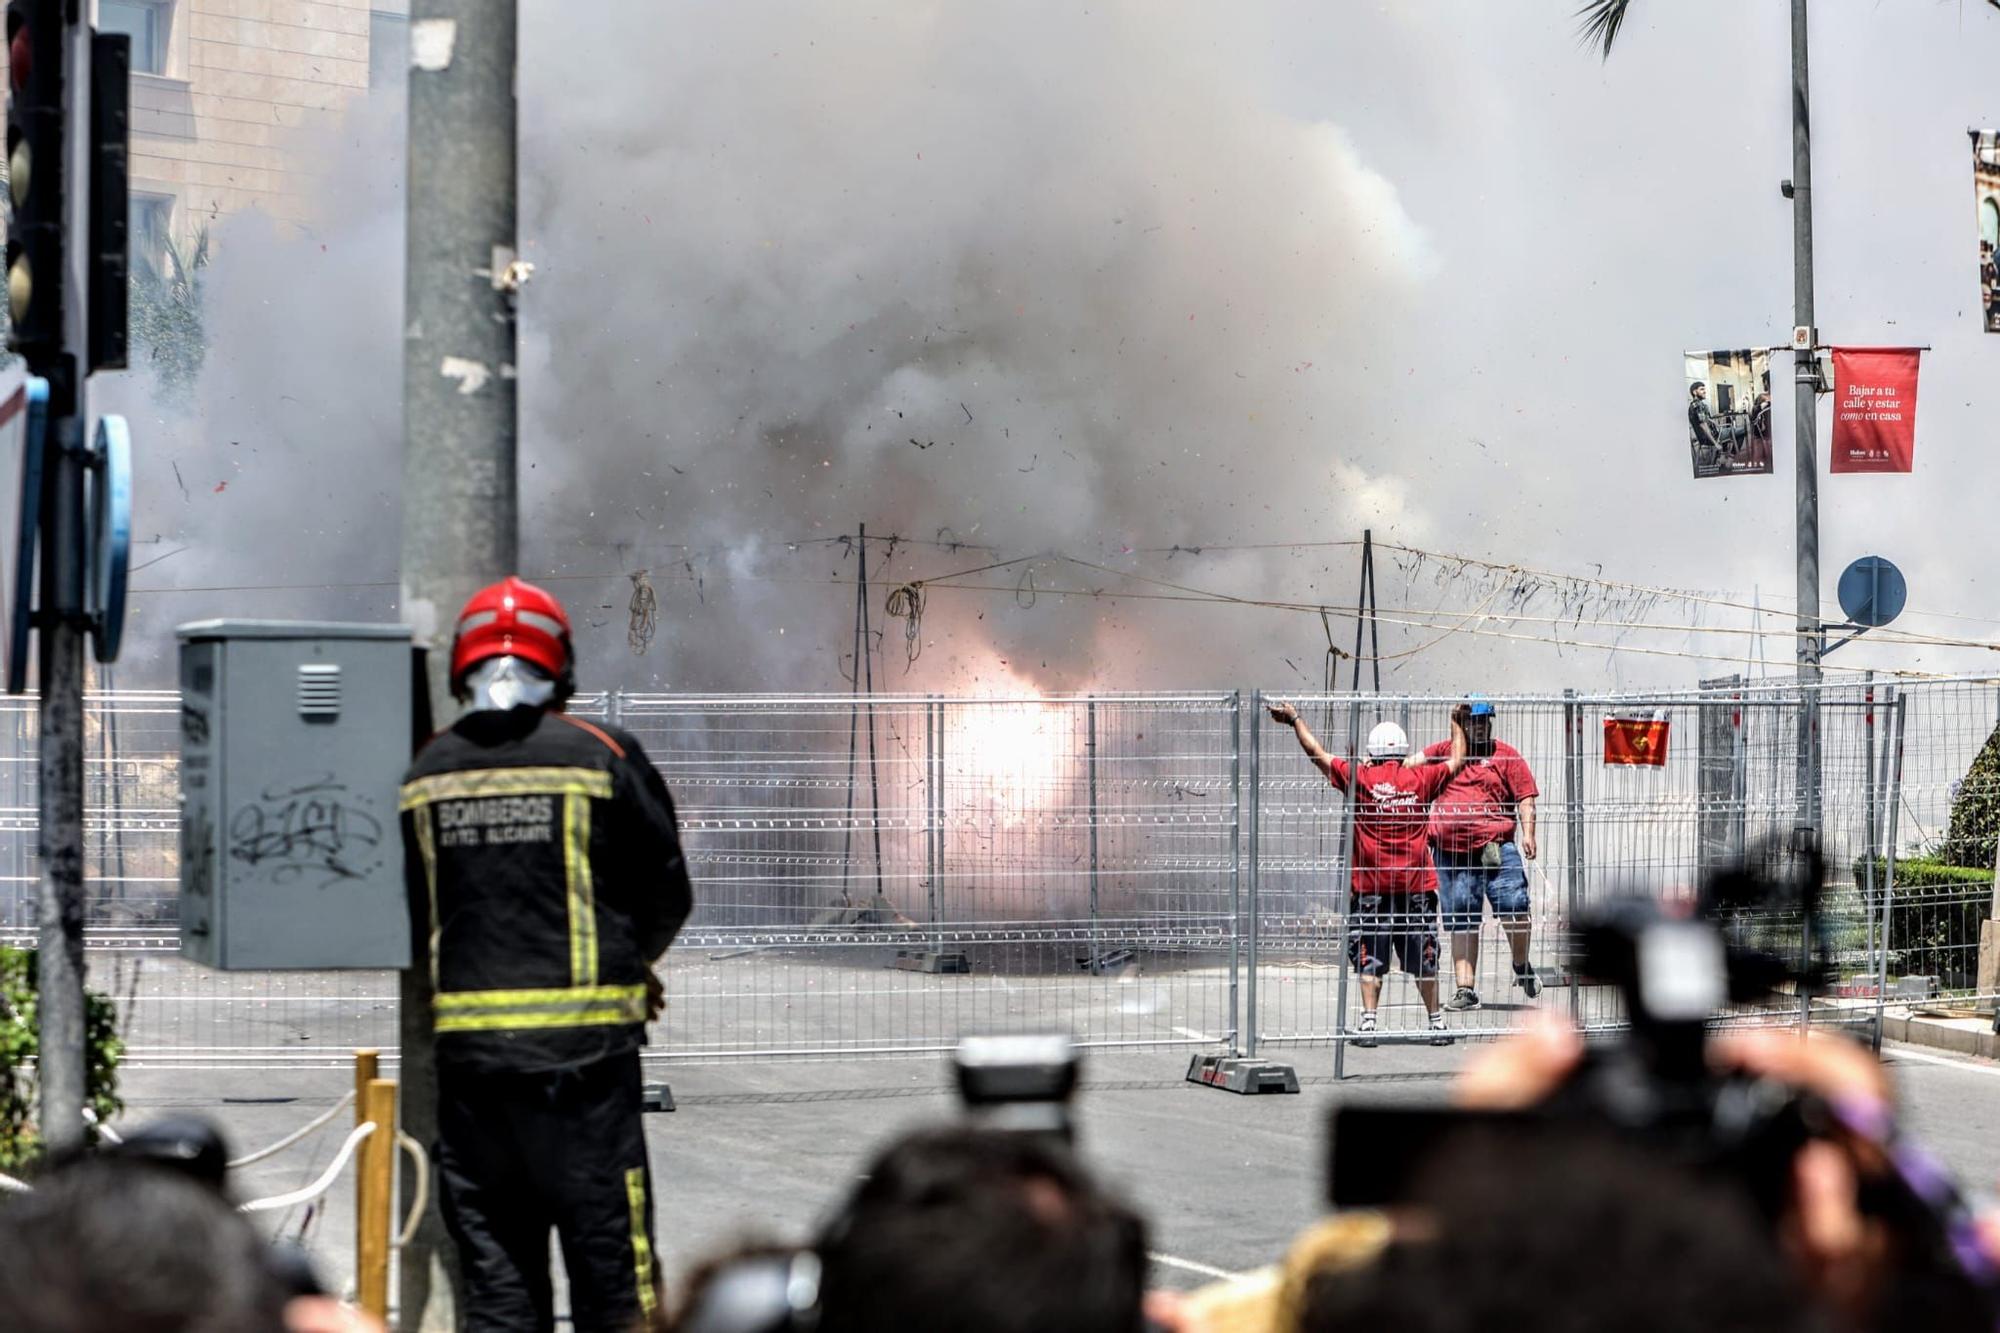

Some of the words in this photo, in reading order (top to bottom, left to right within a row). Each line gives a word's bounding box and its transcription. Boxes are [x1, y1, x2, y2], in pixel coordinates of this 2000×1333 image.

[1849, 385, 1875, 397] Bajar
[1876, 387, 1883, 396] a
[1885, 387, 1895, 396] tu
[1843, 397, 1866, 408] calle
[1867, 399, 1873, 410] y
[1875, 399, 1900, 409] estar
[1840, 412, 1863, 421] como
[1865, 412, 1877, 421] en
[1879, 411, 1901, 421] casa
[438, 797, 553, 829] BOMBEROS
